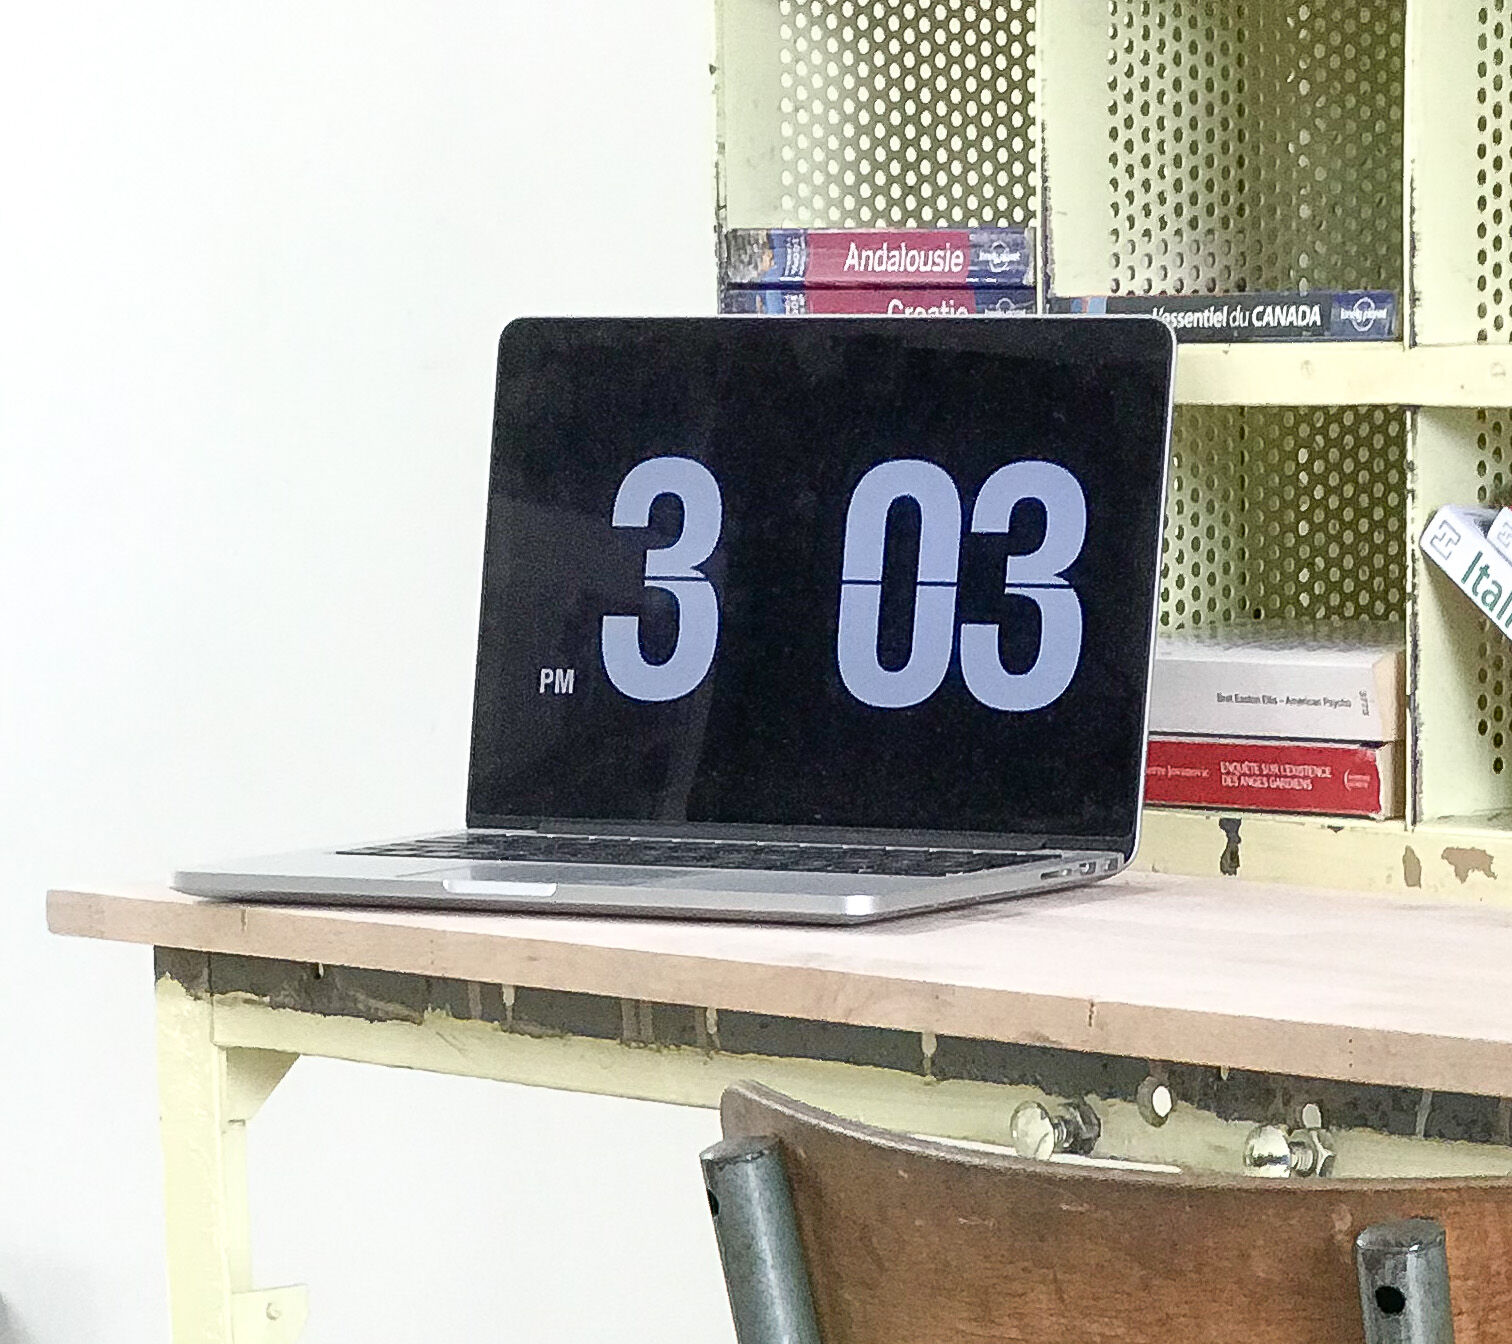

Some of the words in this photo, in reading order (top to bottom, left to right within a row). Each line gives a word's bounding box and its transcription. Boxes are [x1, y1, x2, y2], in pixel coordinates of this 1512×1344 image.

[843, 243, 964, 272] Andalousie
[1230, 306, 1250, 328] du
[1252, 304, 1322, 328] CANADA
[601, 455, 724, 702] 3
[837, 458, 1088, 712] 03
[539, 668, 575, 694] PM
